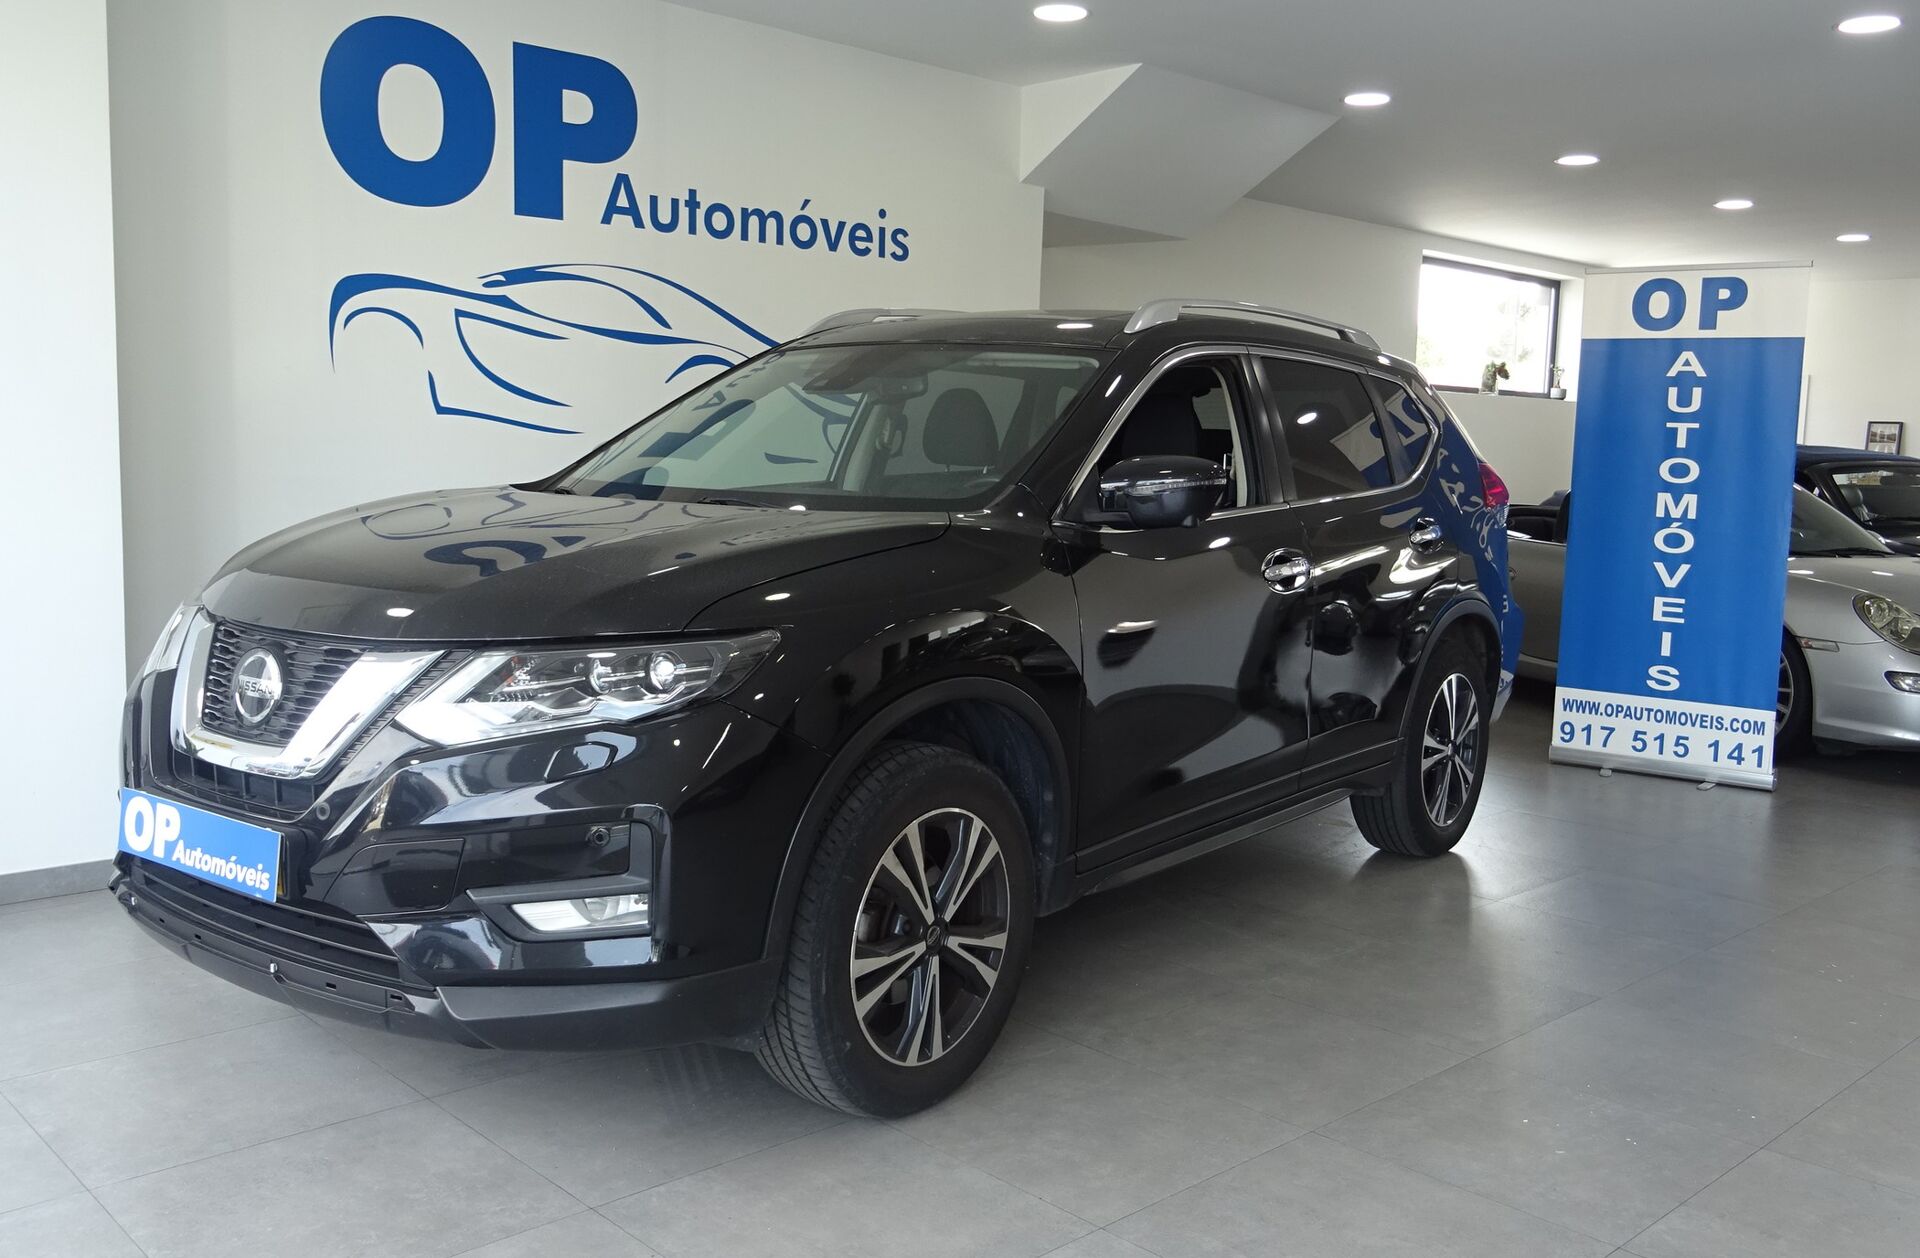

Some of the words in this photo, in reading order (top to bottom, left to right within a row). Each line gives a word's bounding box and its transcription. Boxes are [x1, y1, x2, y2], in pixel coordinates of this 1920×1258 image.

[320, 15, 638, 220] OP
[600, 173, 910, 262] Automóveis
[1632, 276, 1748, 331] OP
[1646, 351, 1707, 691] AUTOMÓVEIS
[1559, 720, 1616, 748] 917
[1631, 730, 1690, 758] 515
[1707, 739, 1764, 768] 141
[1561, 698, 1766, 736] WWW.OPAUTOMOVEIS.COM
[124, 796, 181, 858] OP
[172, 839, 270, 891] Automóveis
